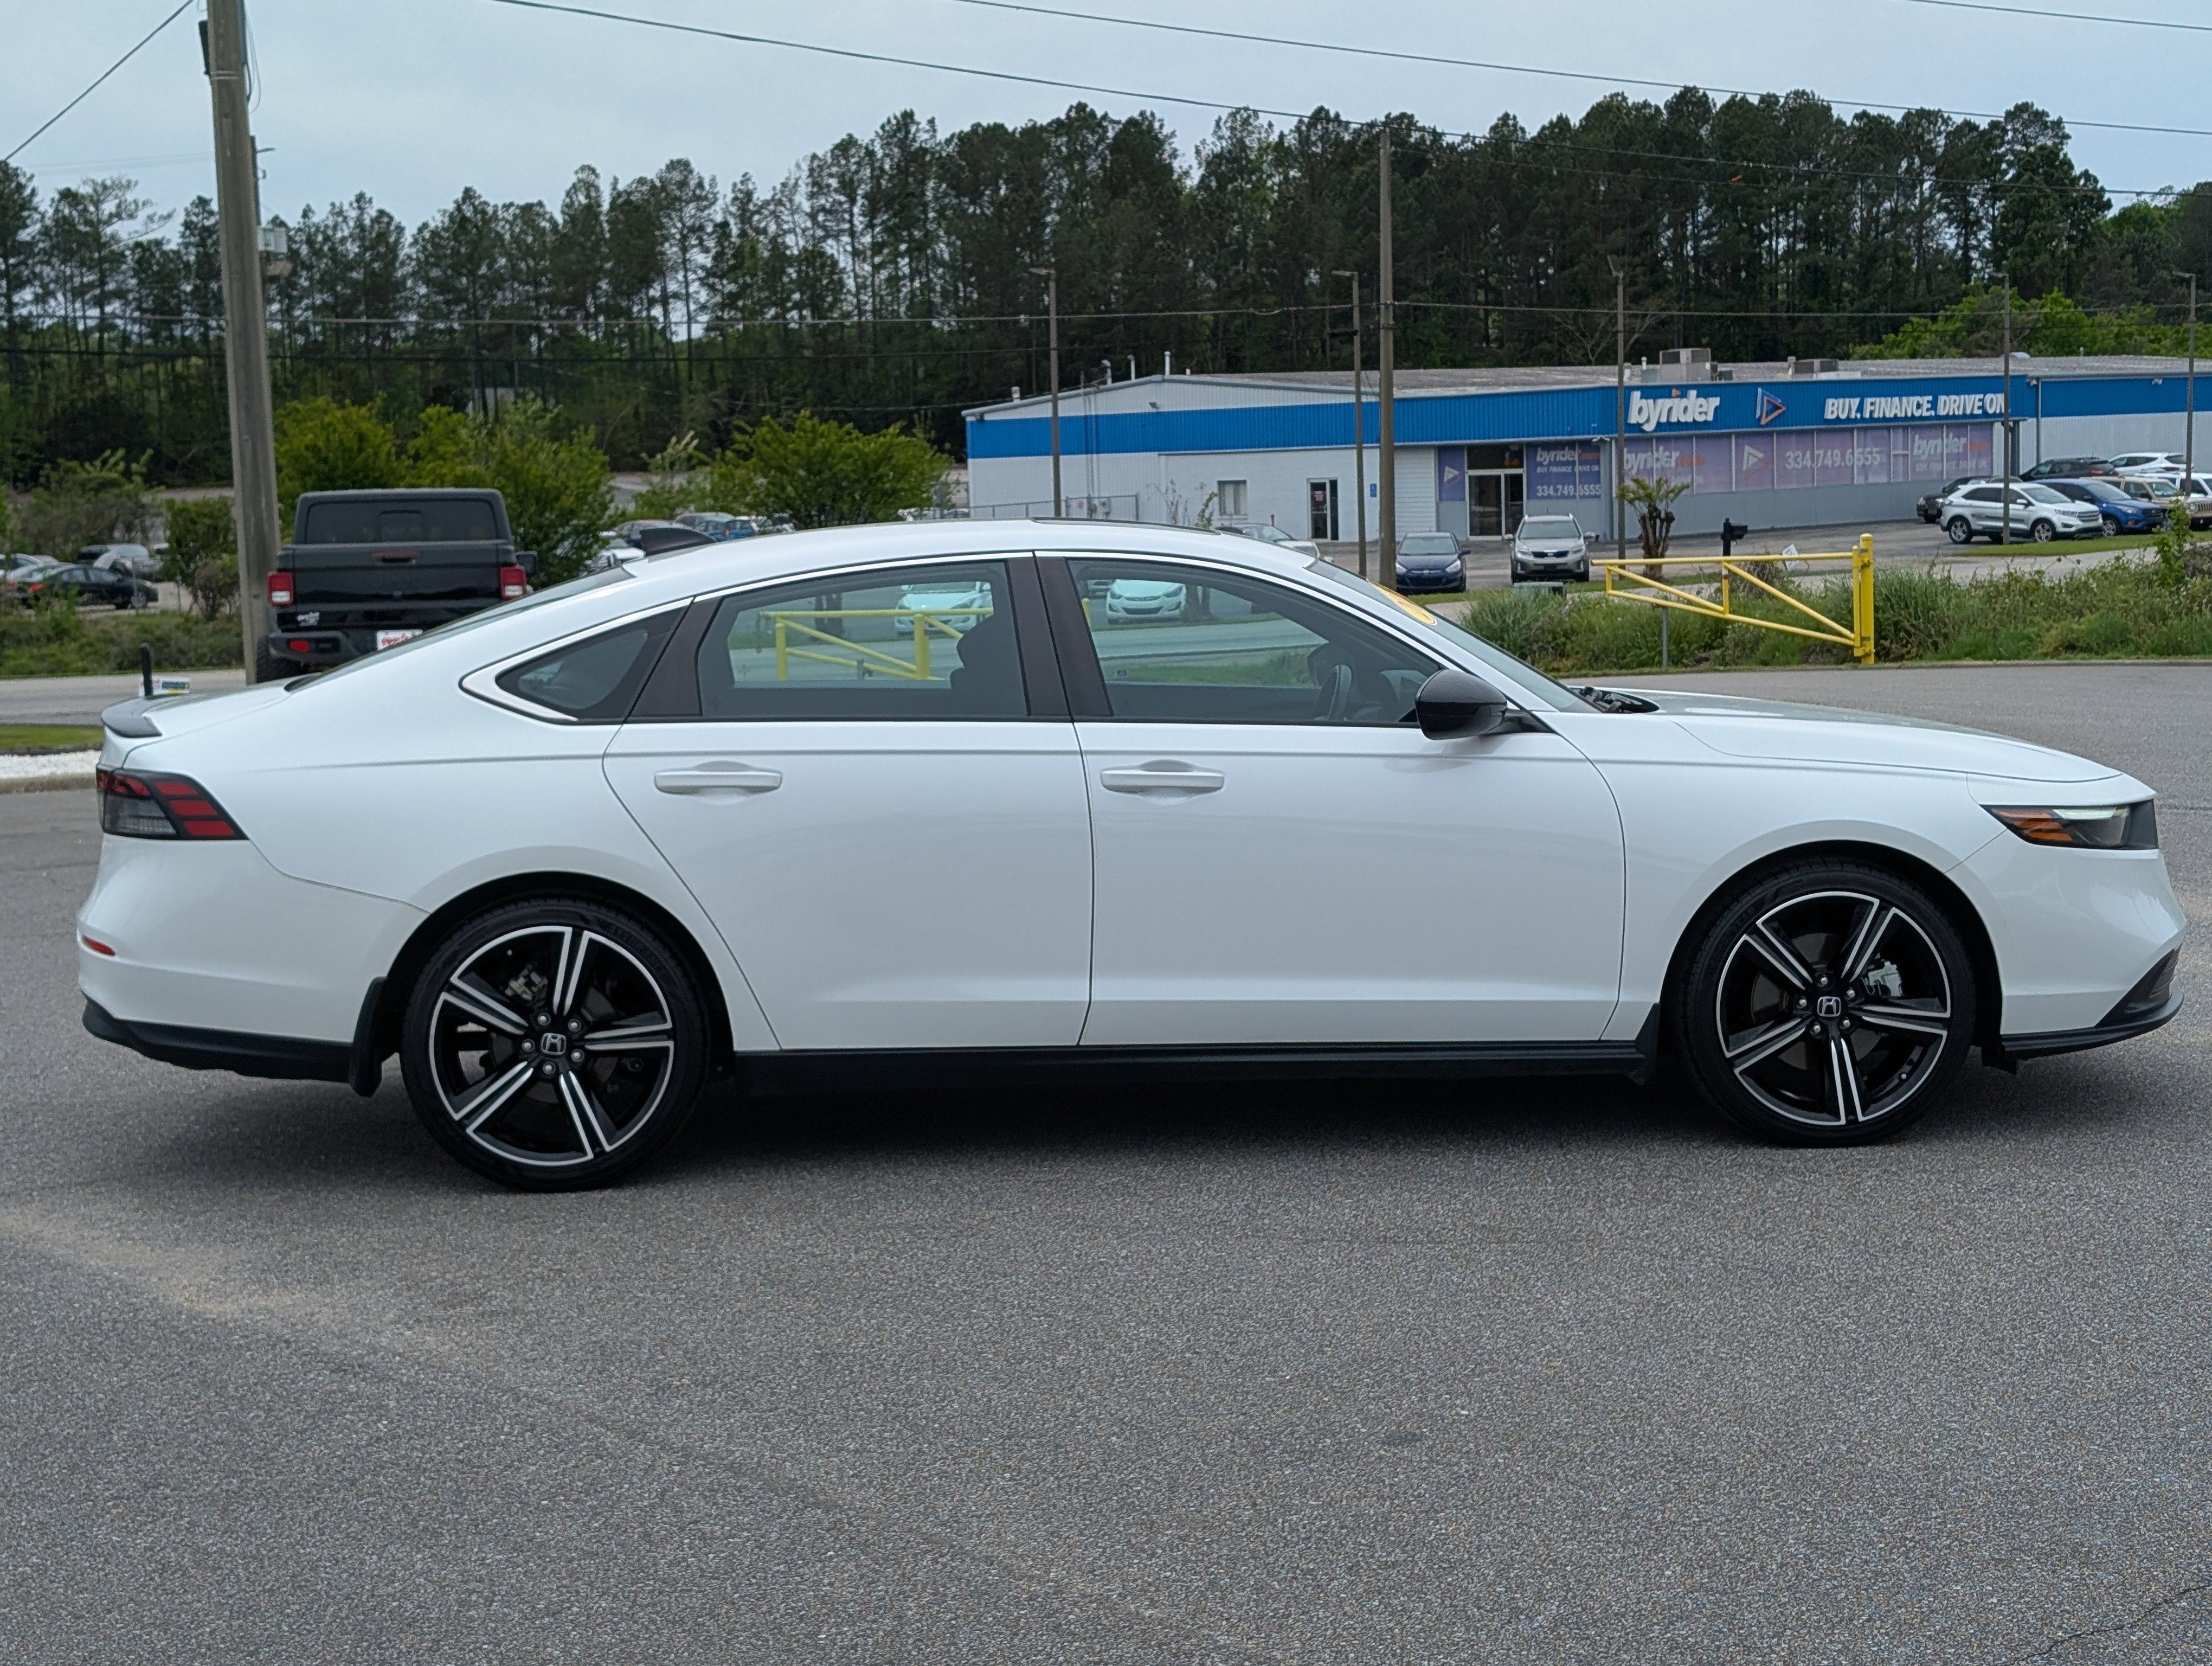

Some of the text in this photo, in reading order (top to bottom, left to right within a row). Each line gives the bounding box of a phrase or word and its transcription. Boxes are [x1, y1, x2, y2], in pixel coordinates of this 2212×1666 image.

[1628, 388, 1720, 432] byrider
[1824, 397, 1861, 419] BUY.
[1862, 395, 1935, 418] FINANCE.
[1937, 394, 1984, 415] DRIVE
